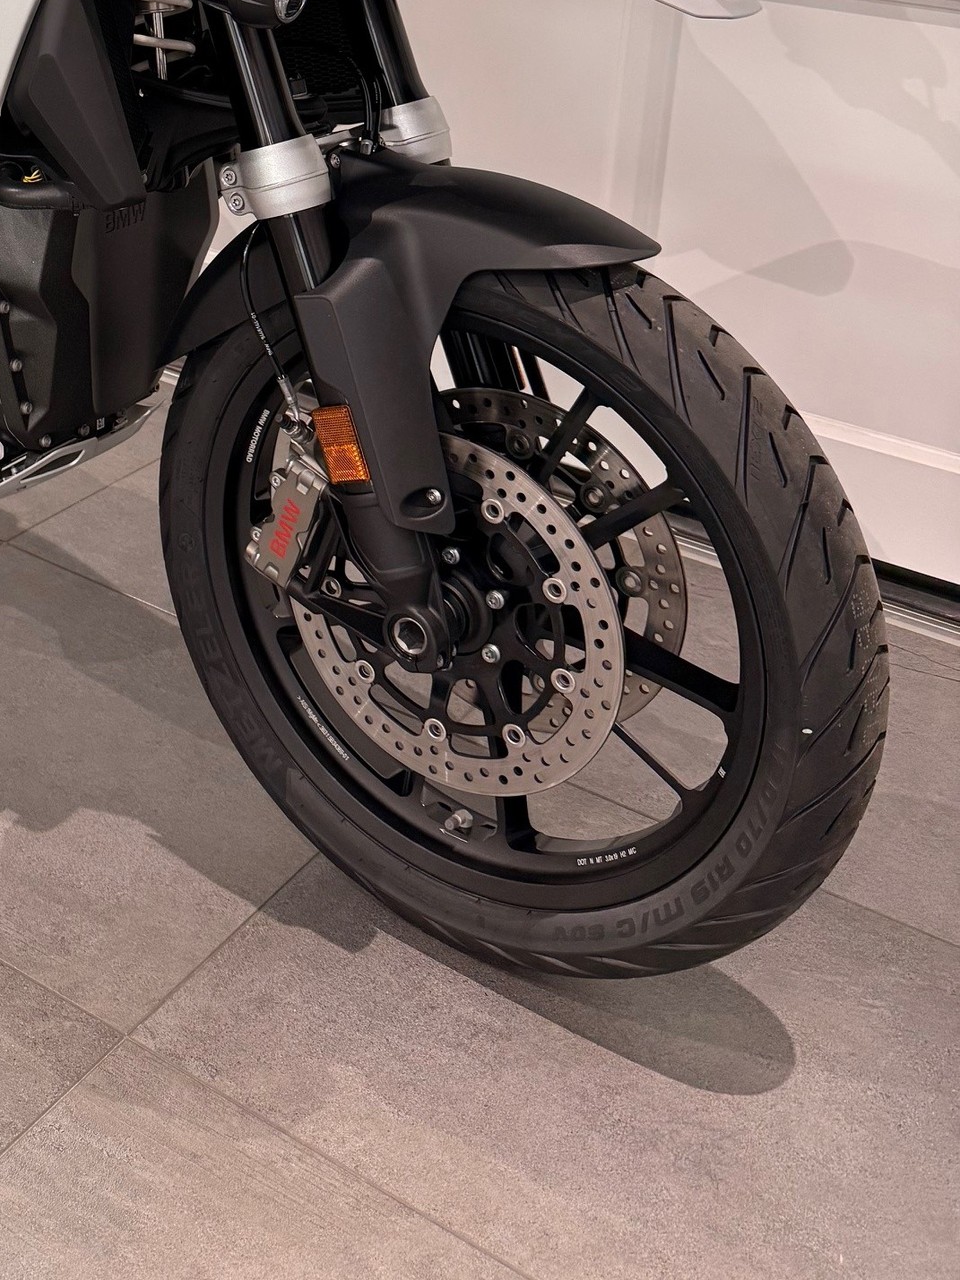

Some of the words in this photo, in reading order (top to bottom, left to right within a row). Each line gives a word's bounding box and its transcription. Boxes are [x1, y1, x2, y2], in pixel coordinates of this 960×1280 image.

[257, 409, 271, 426] BMW
[245, 424, 263, 463] MOTORRAD
[268, 498, 301, 560] BMW
[576, 858, 588, 866] DOT
[690, 854, 736, 906] R19
[616, 896, 685, 939] M/C
